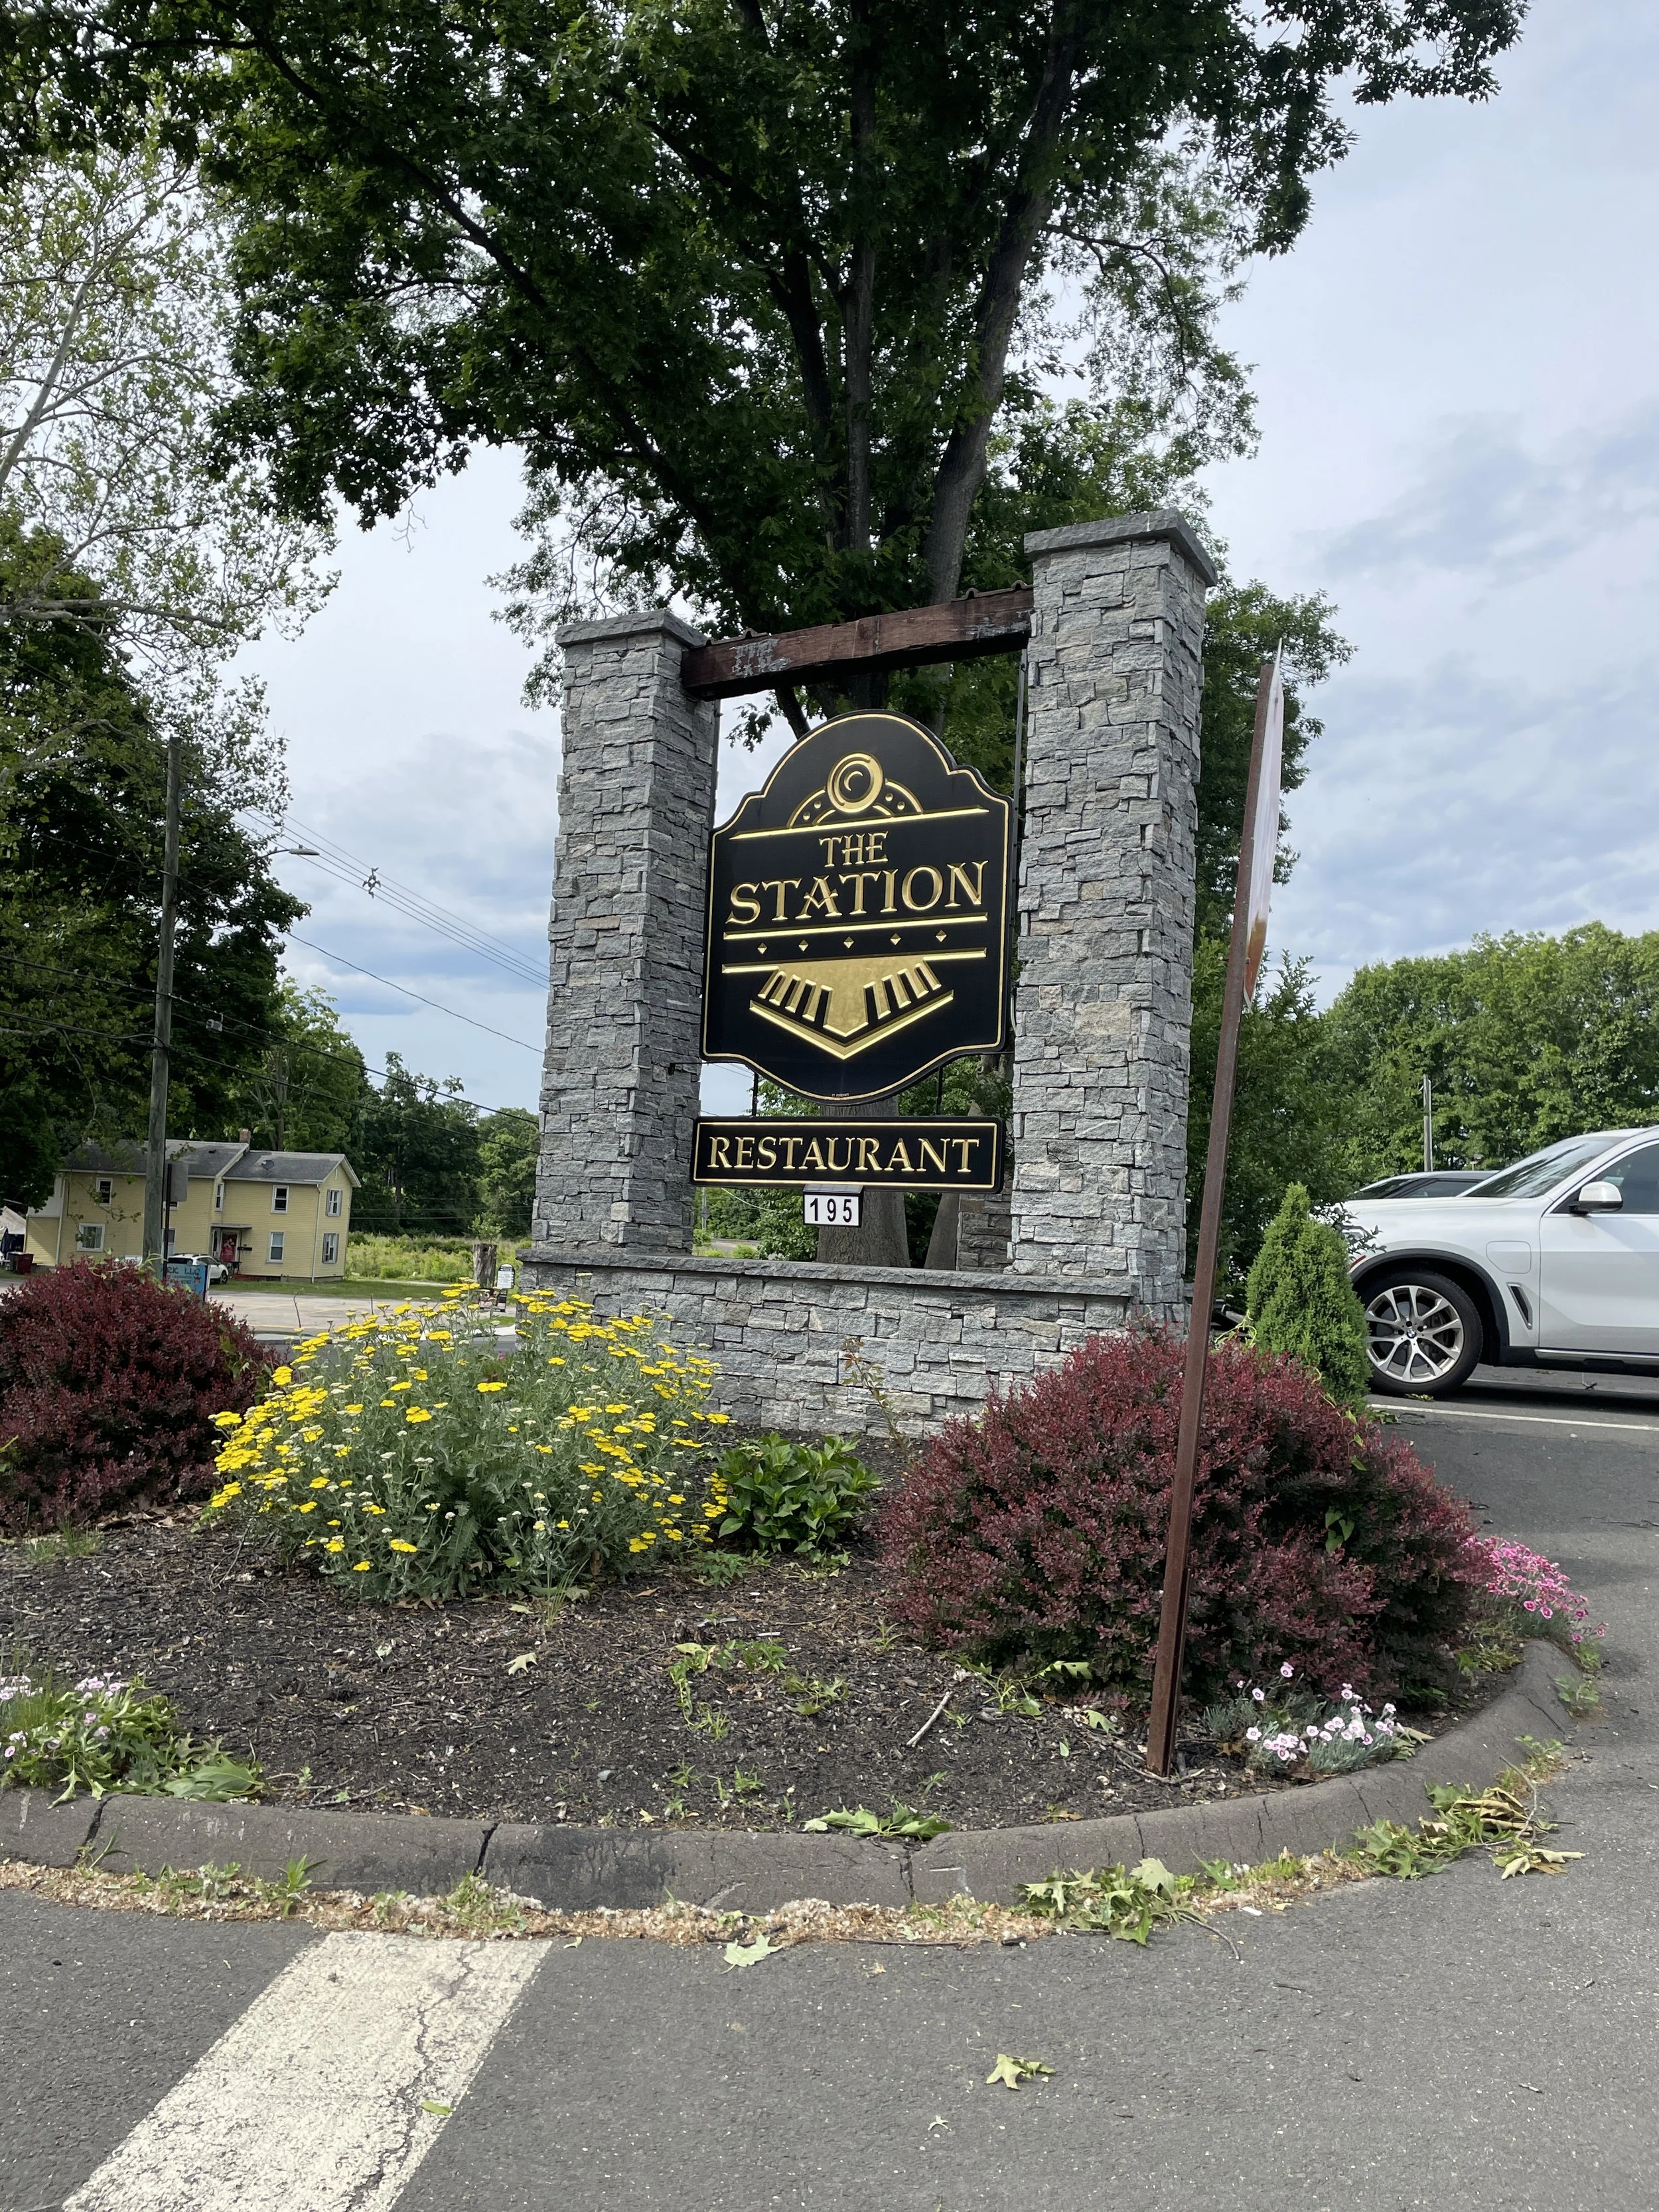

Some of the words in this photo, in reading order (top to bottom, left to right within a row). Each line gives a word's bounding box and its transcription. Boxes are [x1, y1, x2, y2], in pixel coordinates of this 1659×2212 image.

[818, 831, 889, 867] THE
[725, 860, 989, 924] STATION
[707, 1136, 980, 1173] RESTAURANT
[810, 1197, 852, 1222] 195
